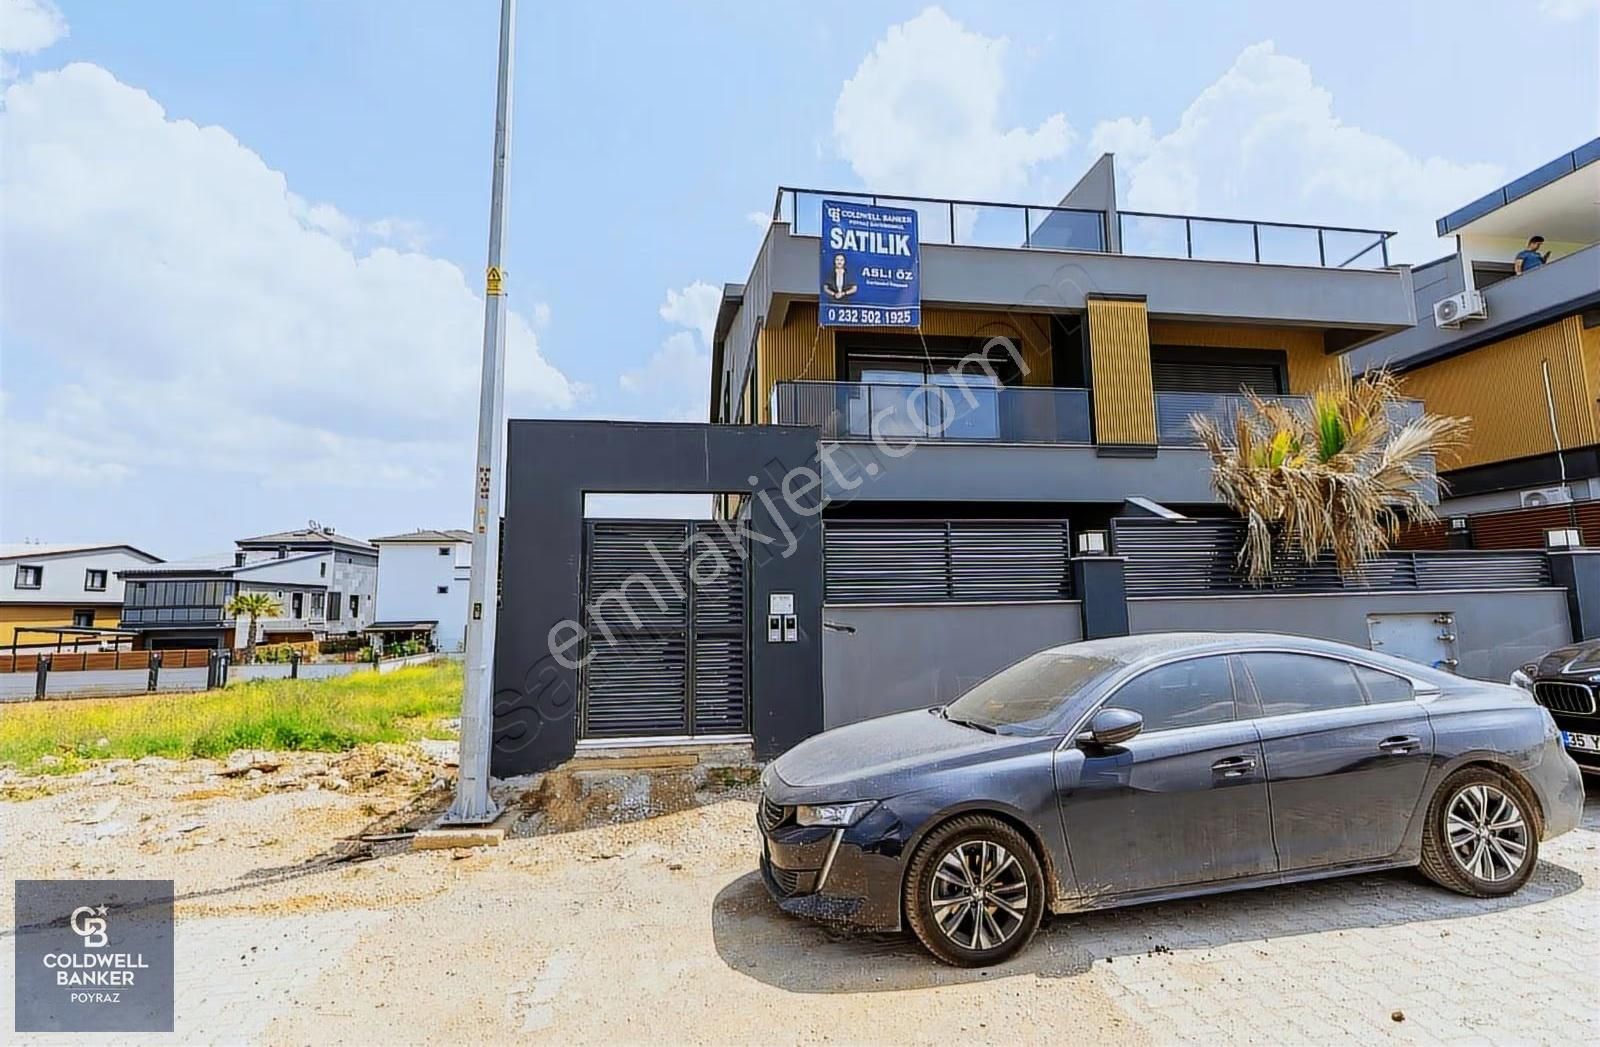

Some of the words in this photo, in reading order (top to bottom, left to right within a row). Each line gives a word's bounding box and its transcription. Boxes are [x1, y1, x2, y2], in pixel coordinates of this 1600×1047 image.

[830, 227, 911, 257] SATILIK
[862, 267, 892, 279] ASLI
[896, 268, 913, 281] ÖZ
[828, 308, 835, 321] 0
[838, 309, 858, 323] 232
[861, 310, 881, 324] 502
[885, 310, 911, 324] 1925
[1568, 733, 1585, 748] 35
